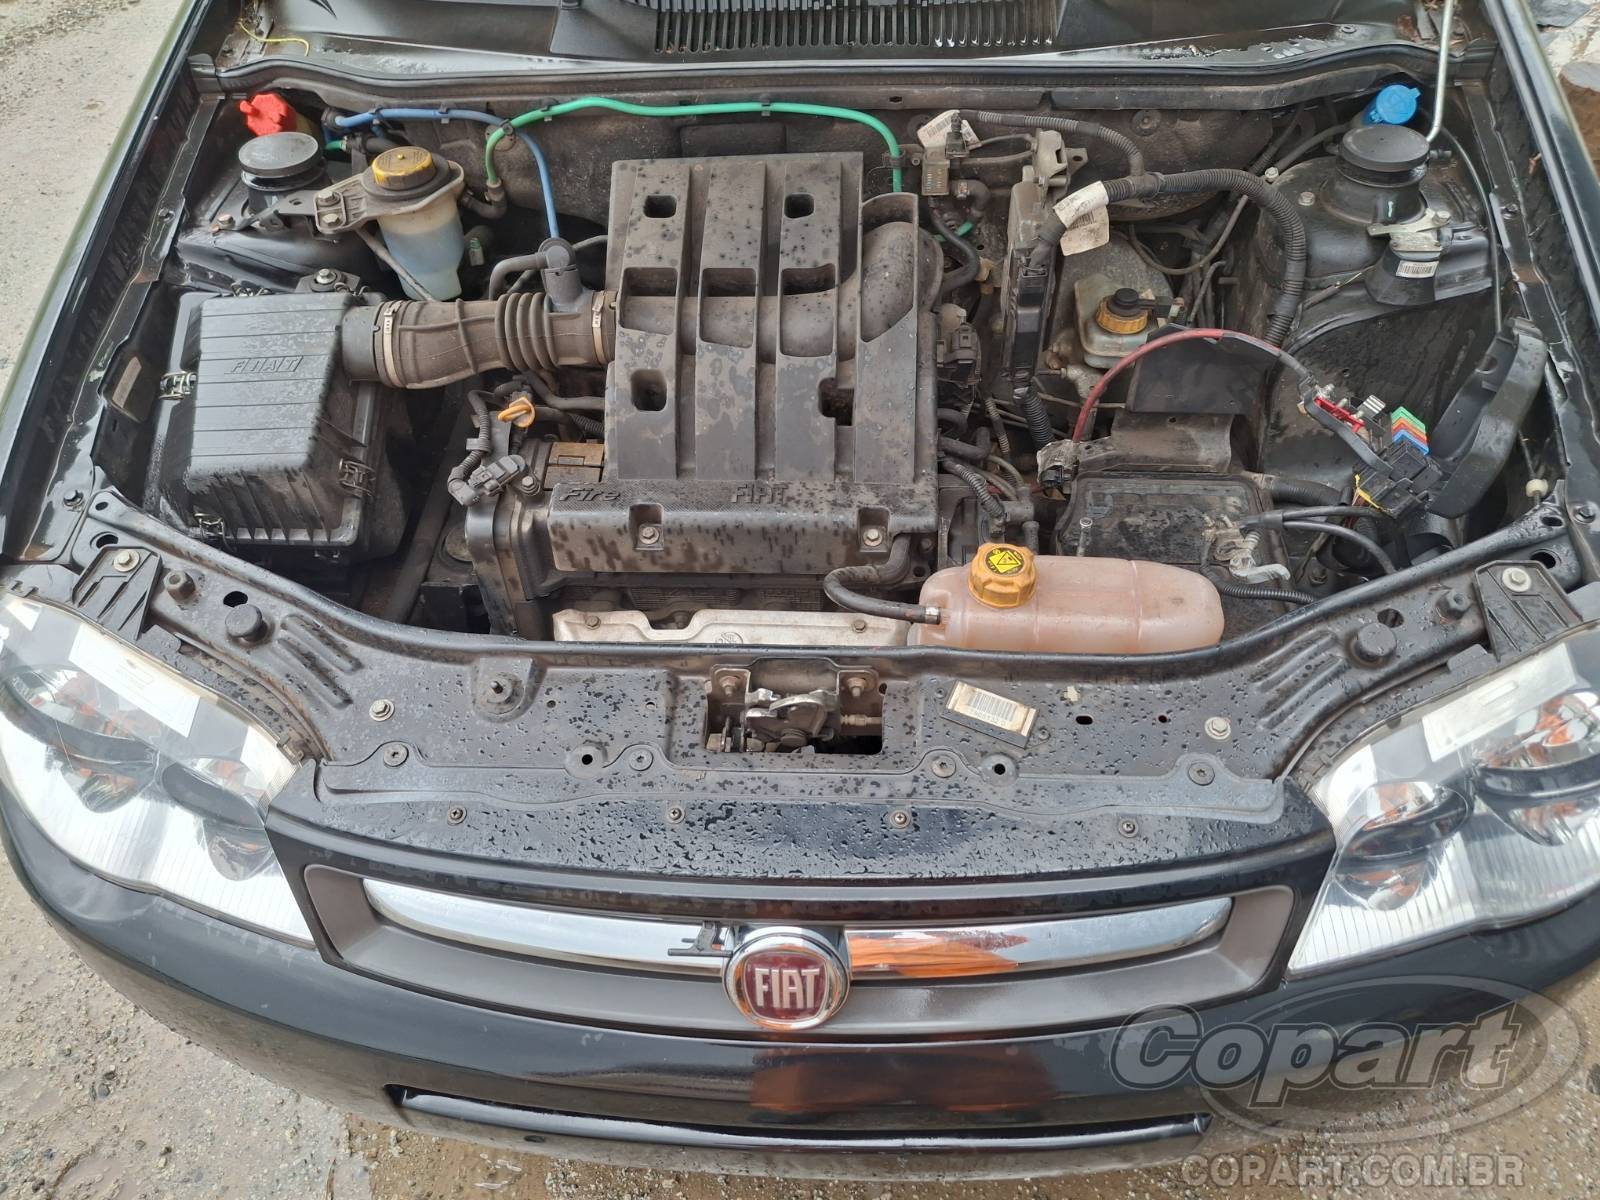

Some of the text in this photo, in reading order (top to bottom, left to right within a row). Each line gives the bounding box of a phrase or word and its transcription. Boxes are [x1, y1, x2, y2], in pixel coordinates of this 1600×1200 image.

[230, 356, 303, 374] FIAT
[731, 482, 789, 505] FIAT
[754, 967, 821, 1010] FIAT
